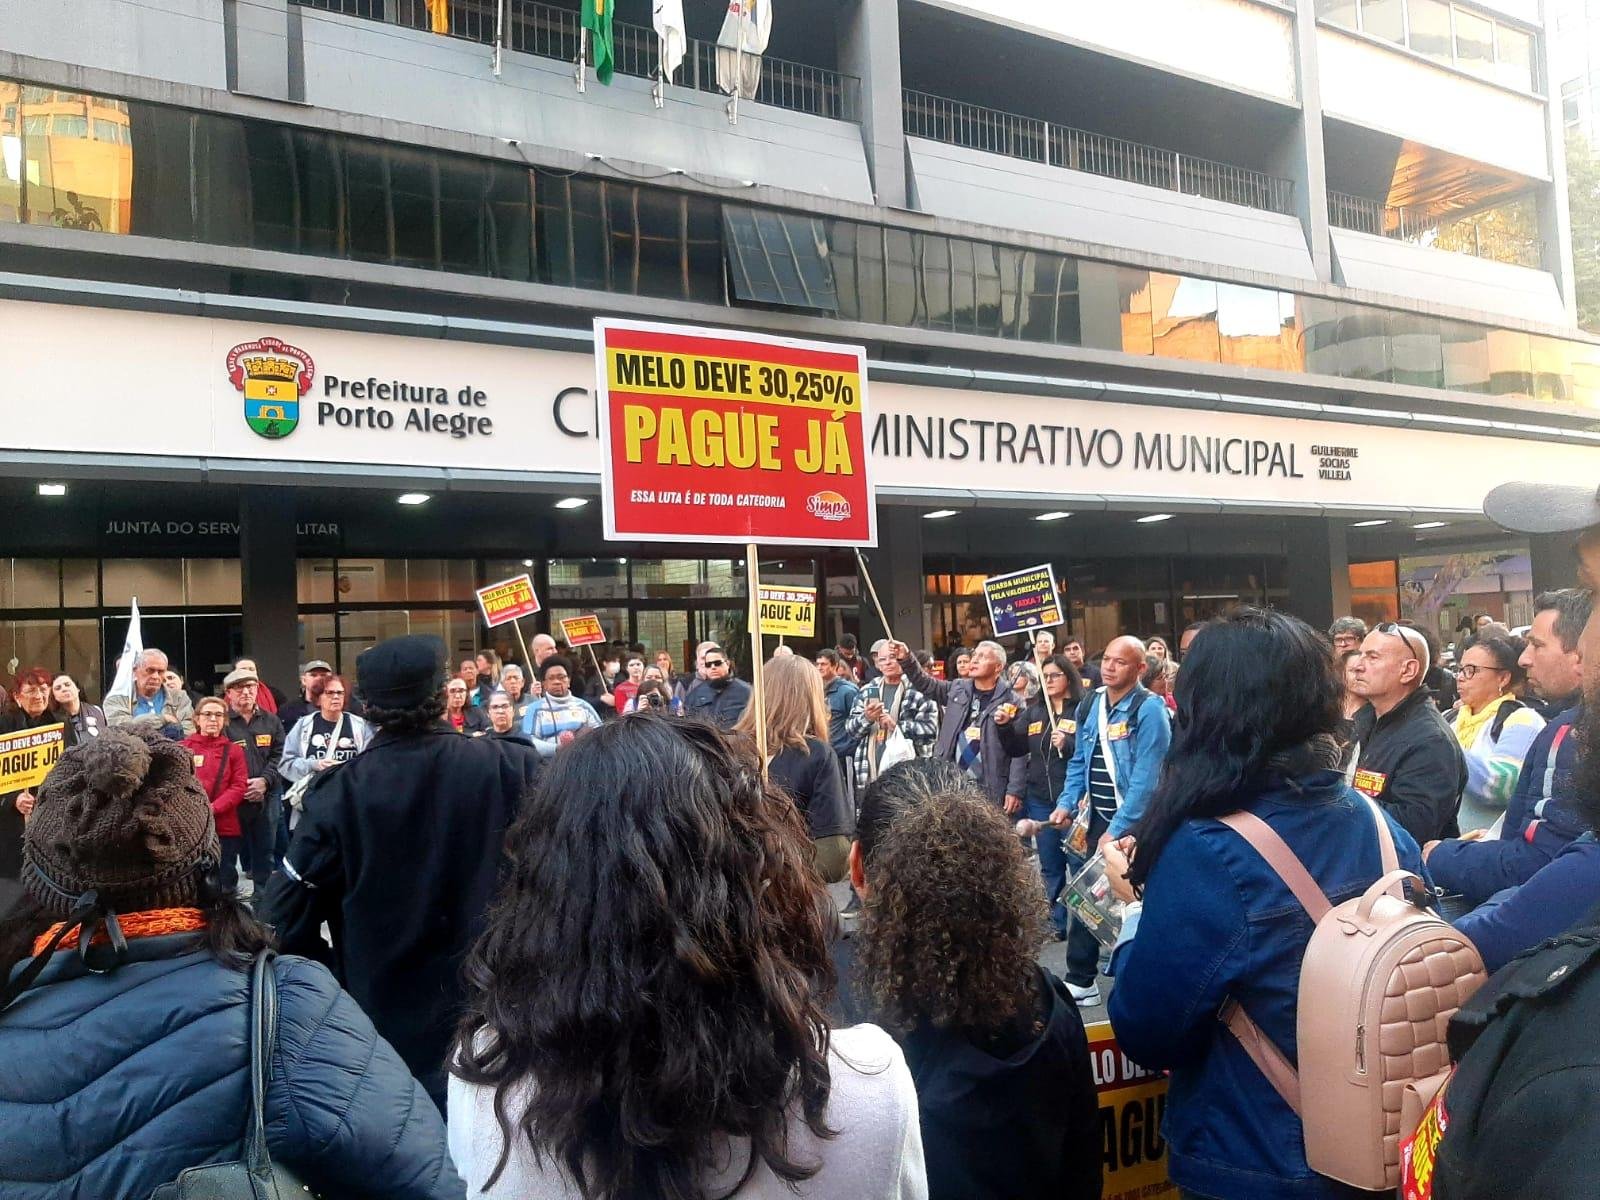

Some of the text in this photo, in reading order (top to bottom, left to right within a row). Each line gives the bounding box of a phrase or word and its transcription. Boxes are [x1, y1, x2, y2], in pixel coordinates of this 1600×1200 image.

[616, 353, 853, 406] MELO DEVE 30,25%
[324, 376, 487, 407] Prefeitura de
[318, 402, 492, 439] Porto Alegre
[624, 404, 853, 475] PAGUE JÁ
[1133, 431, 1304, 479] MUNICIPAL
[1311, 445, 1359, 458] GUILHERME
[1319, 457, 1351, 469] SOCIAS
[1318, 469, 1352, 480] VILLELA
[630, 489, 786, 508] ESSA LUTA É DE TODA CATEGORIA
[807, 496, 851, 516] Simpa
[106, 521, 162, 535] JUNTA
[167, 522, 194, 535] DO
[1012, 572, 1049, 586] MUNICIPAL
[485, 594, 518, 614] PAGUE
[991, 591, 1007, 601] PELA
[760, 602, 811, 622] AGUE JÁ
[12, 736, 31, 750] DEVE
[0, 740, 60, 777] AGUE JÁ
[1091, 1048, 1116, 1085] LO
